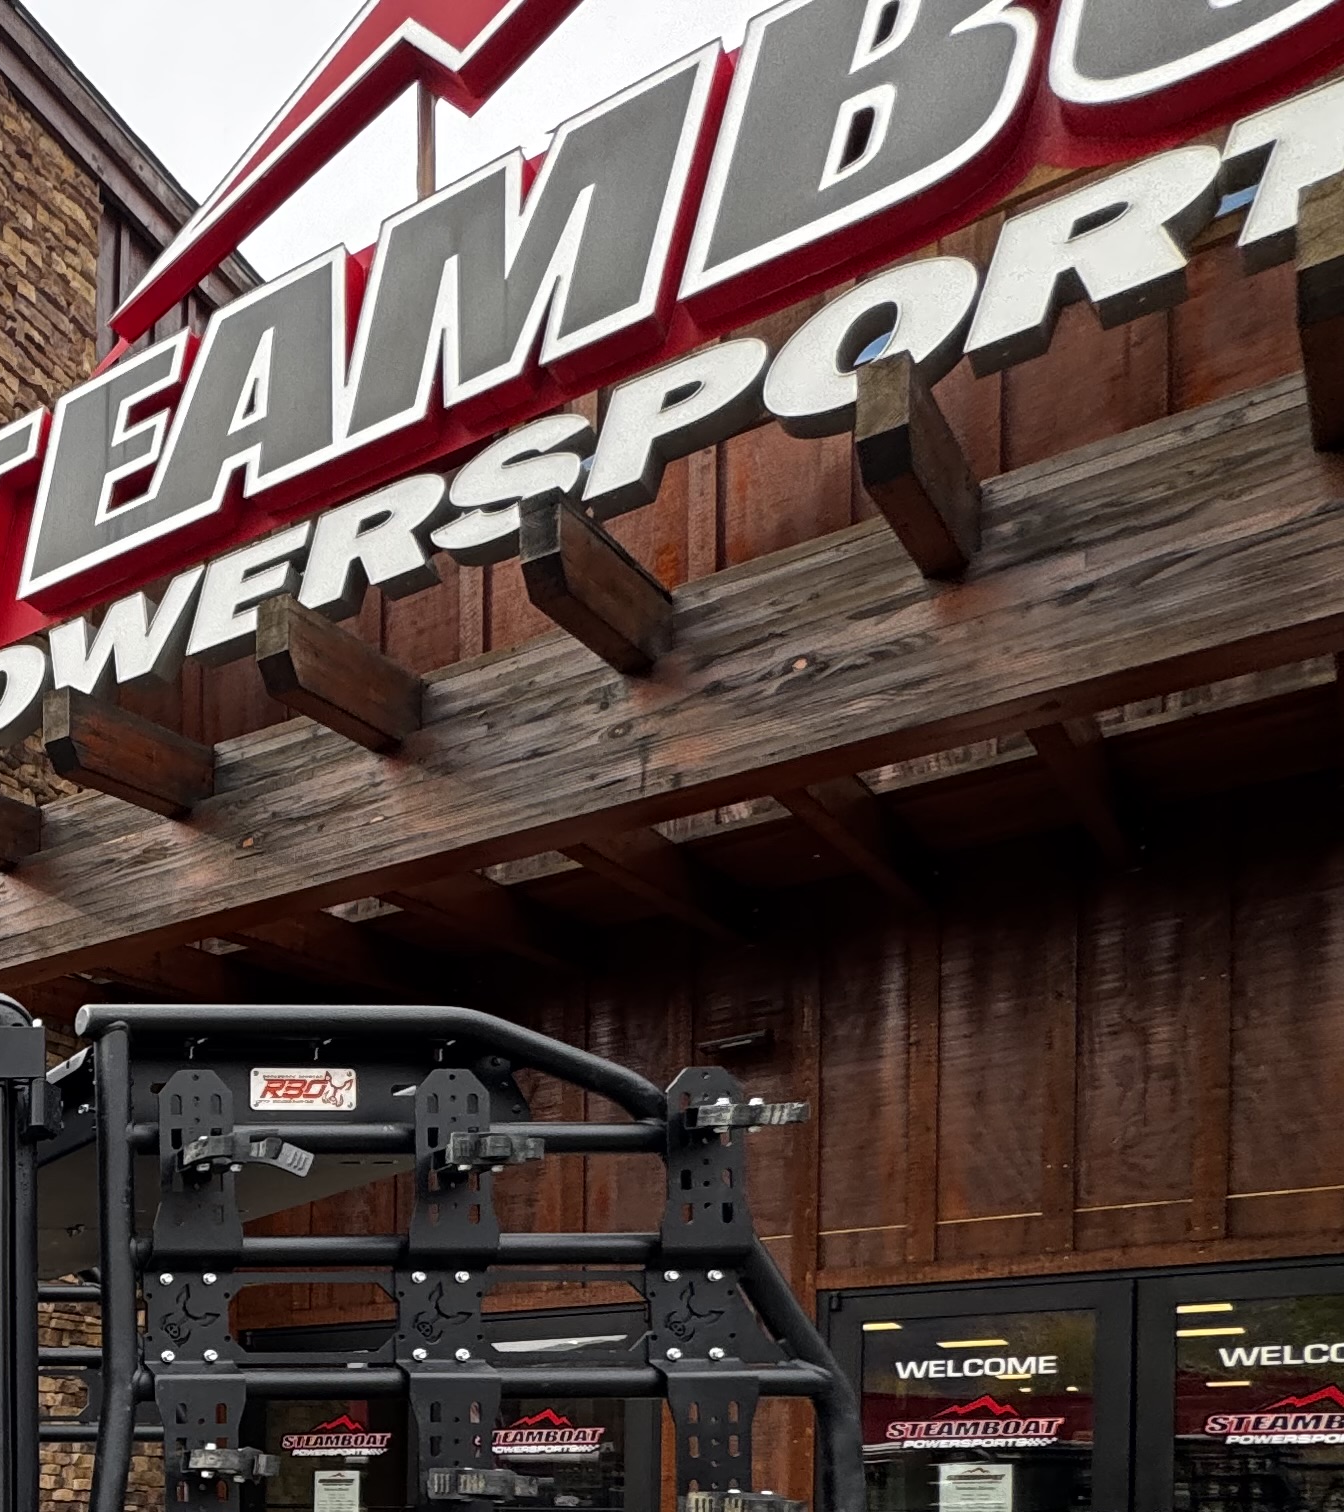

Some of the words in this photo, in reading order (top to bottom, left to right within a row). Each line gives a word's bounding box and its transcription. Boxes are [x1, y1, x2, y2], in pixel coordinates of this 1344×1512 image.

[895, 1355, 1058, 1379] WELCOME
[886, 1417, 1065, 1438] STEAMBOAT
[282, 1433, 392, 1449] STEAMBOAT
[492, 1428, 605, 1445] TEAMBOAT
[903, 1439, 1029, 1449] POWERSPORTS
[1225, 1434, 1344, 1444] POWERSPO
[492, 1445, 577, 1454] OWERSPORTS
